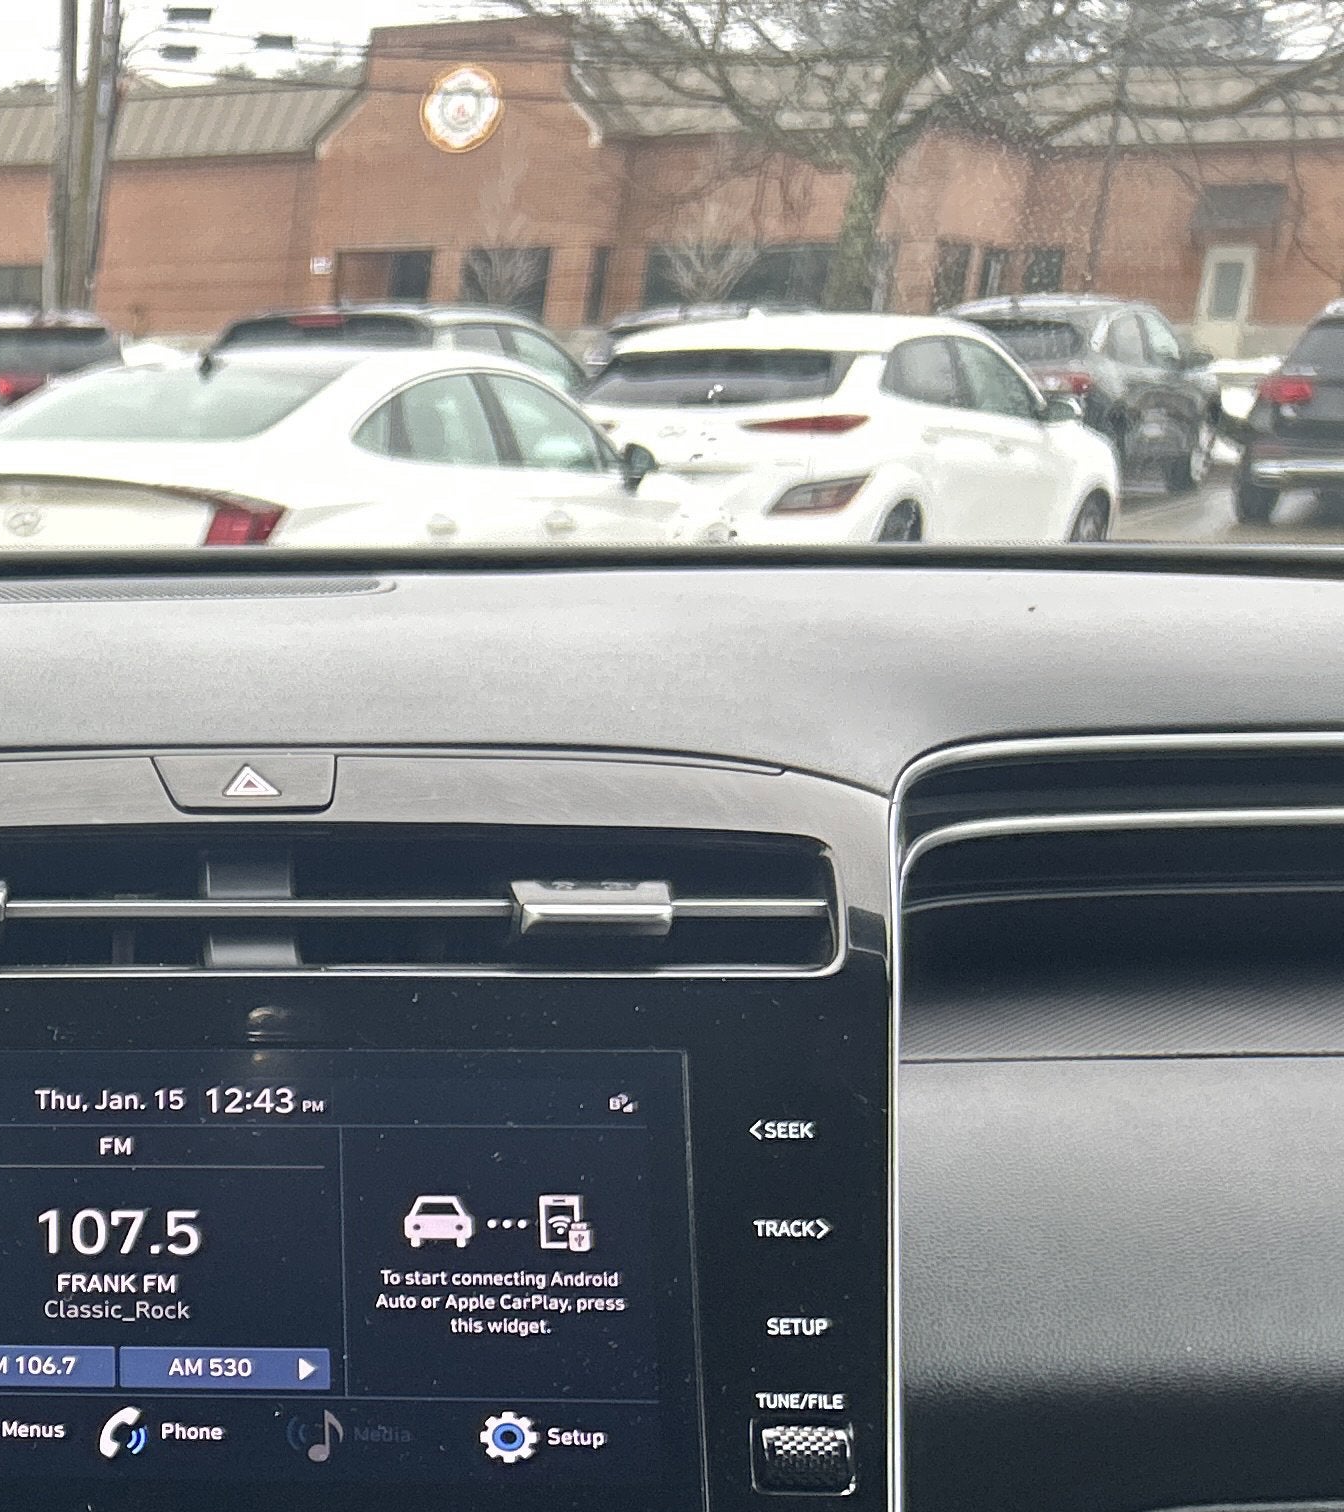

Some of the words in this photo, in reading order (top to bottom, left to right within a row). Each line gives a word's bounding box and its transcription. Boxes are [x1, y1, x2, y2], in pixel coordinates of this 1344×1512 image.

[34, 1089, 88, 1112] Thu,
[94, 1089, 146, 1112] Jan.
[154, 1089, 185, 1111] 15
[204, 1086, 296, 1114] 12:43
[301, 1099, 325, 1114] PM
[99, 1137, 133, 1156] FM
[37, 1207, 202, 1256] 107.5
[56, 1274, 136, 1294] FRANK
[143, 1275, 177, 1294] FM
[381, 1270, 401, 1287] To
[404, 1270, 448, 1287] start
[451, 1270, 547, 1290] connecting
[550, 1270, 620, 1288] Android
[43, 1300, 191, 1322] Classic_Rock
[376, 1294, 417, 1310] Auto
[420, 1297, 440, 1310] or
[445, 1294, 496, 1314] Apple
[576, 1299, 626, 1315] press
[450, 1318, 484, 1335] this
[487, 1318, 552, 1338] widget.
[766, 1317, 830, 1336] SETUP
[15, 1356, 77, 1376] 106.7
[167, 1358, 204, 1377] AM
[209, 1358, 253, 1378] 530
[755, 1392, 845, 1411] TUNE/FILE
[1, 1421, 66, 1439] Menus
[161, 1423, 224, 1441] Phone
[546, 1428, 607, 1450] Setup
